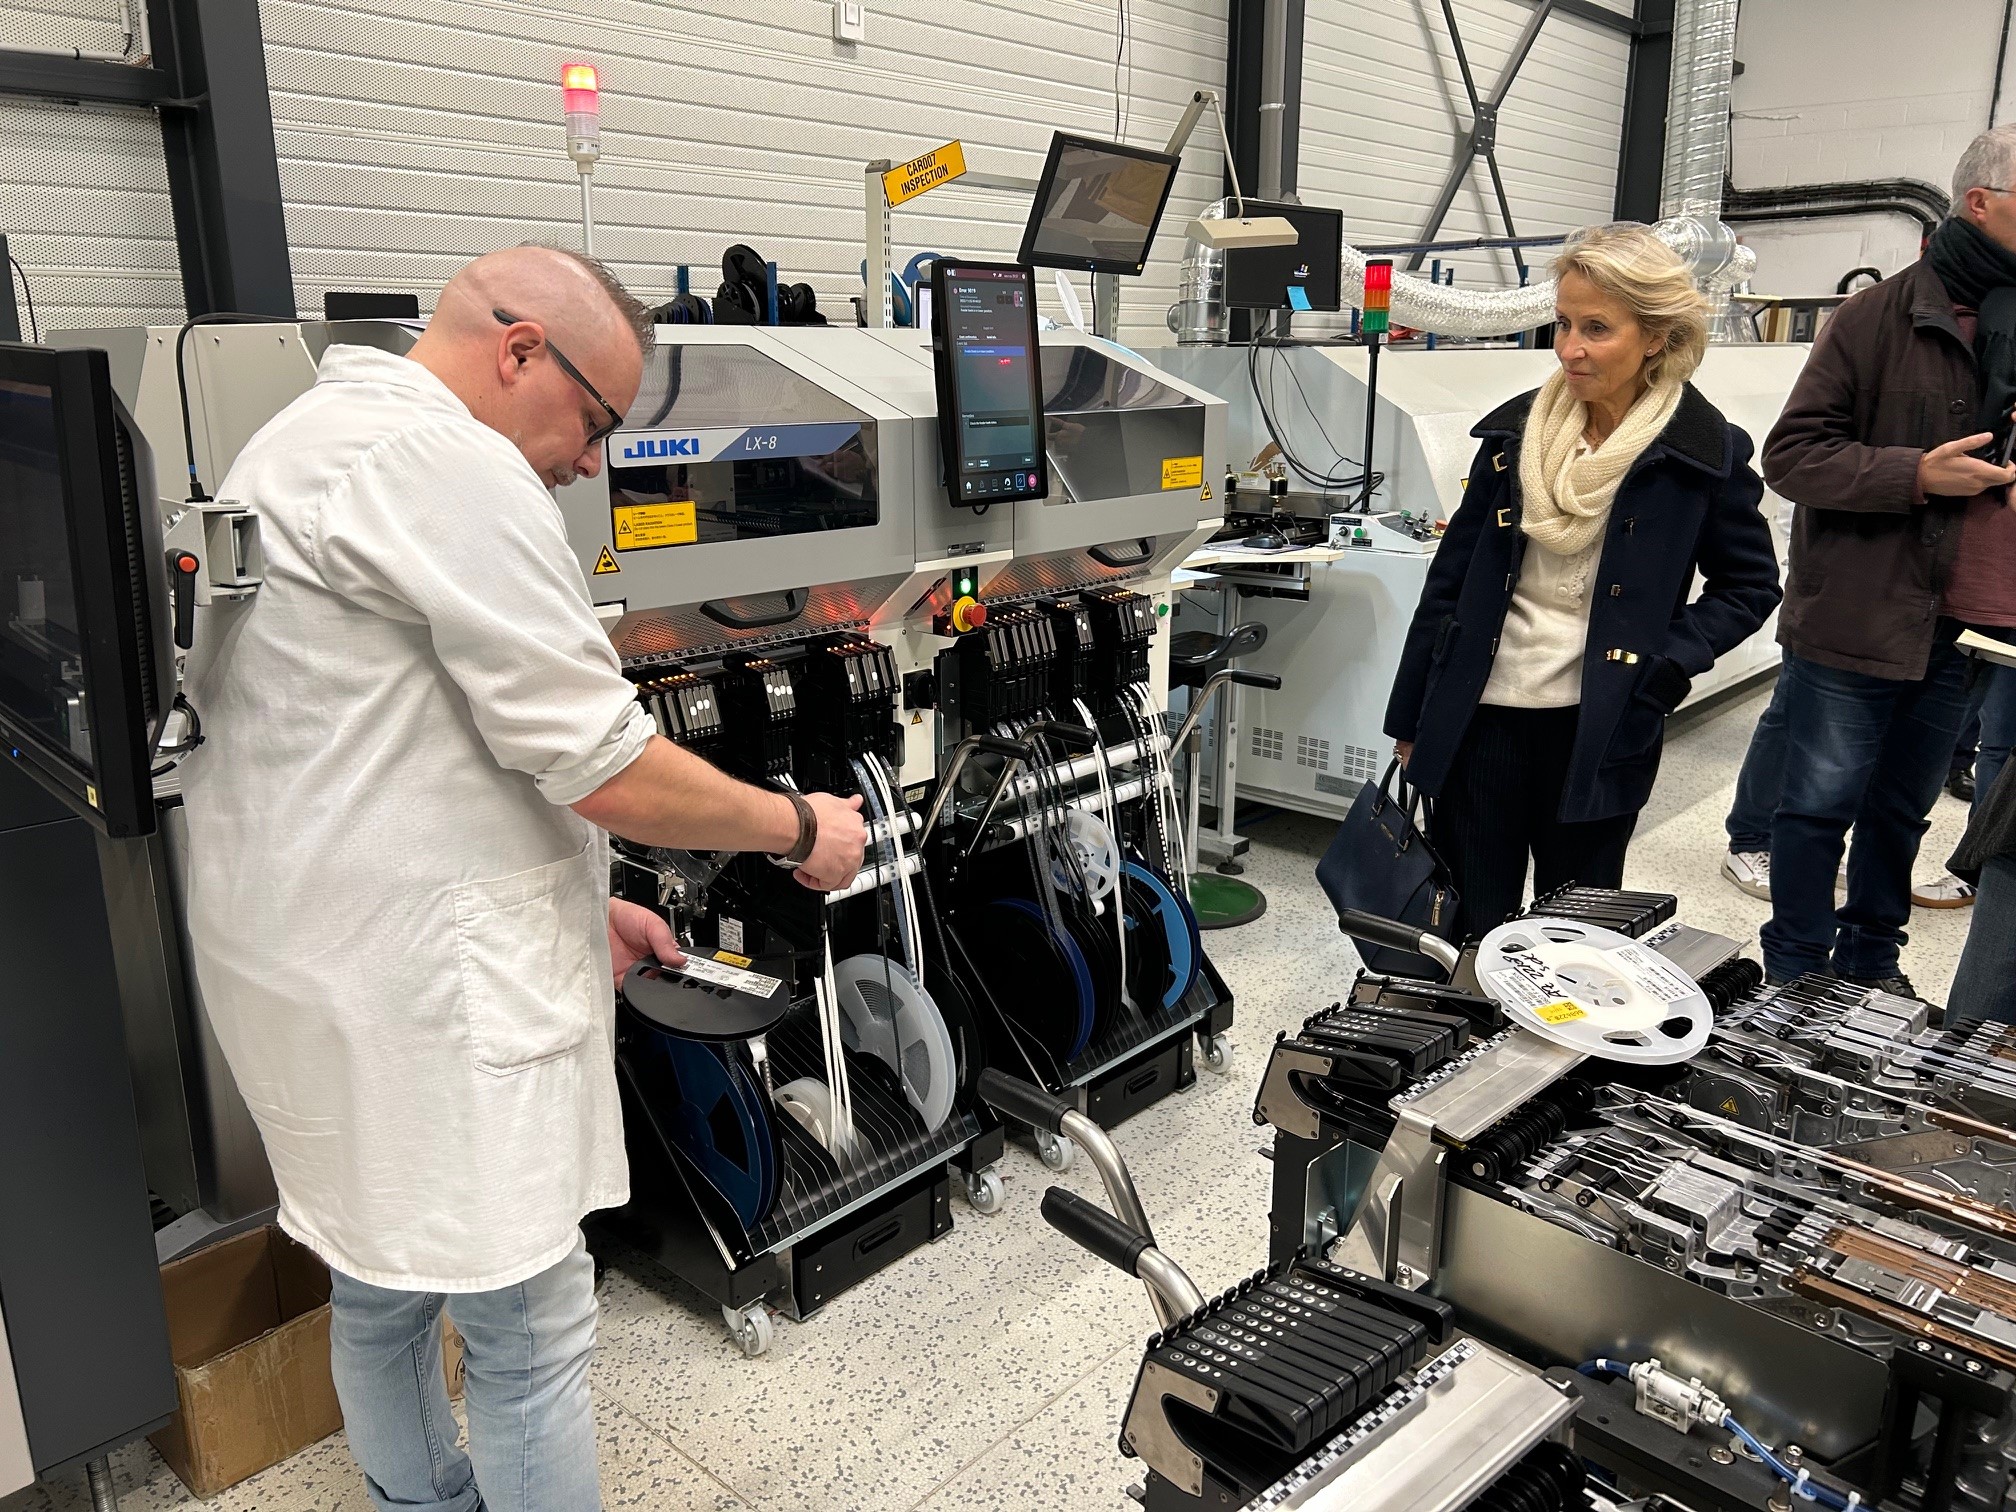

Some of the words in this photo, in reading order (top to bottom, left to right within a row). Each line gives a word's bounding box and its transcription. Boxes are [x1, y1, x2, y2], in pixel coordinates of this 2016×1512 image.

[906, 153, 936, 177] CAR007
[900, 164, 949, 196] INSPECTION
[624, 438, 700, 458] JUKI
[745, 436, 777, 450] LX-8
